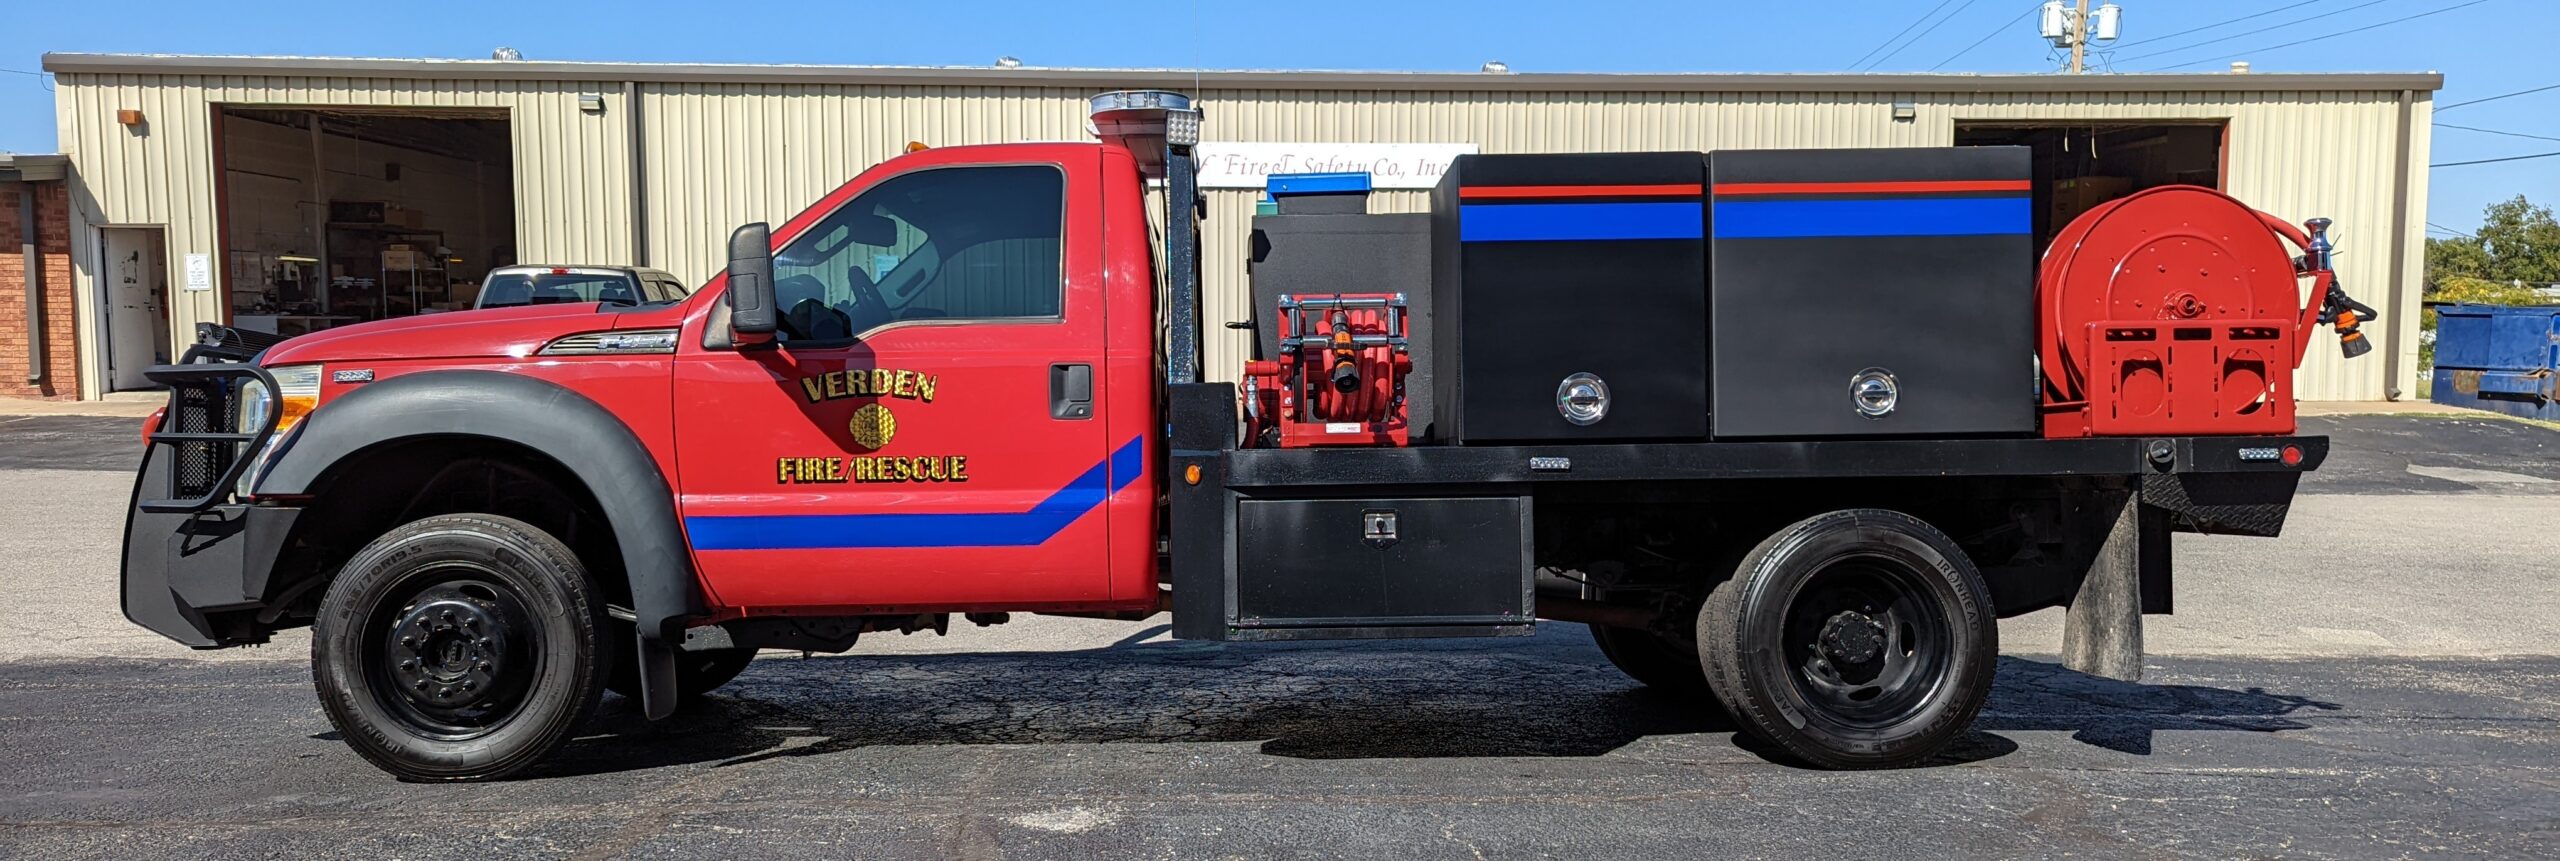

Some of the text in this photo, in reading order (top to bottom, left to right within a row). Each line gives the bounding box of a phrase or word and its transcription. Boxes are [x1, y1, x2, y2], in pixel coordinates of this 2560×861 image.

[1224, 154, 1268, 176] Fire
[801, 368, 938, 403] VERDEN
[777, 456, 969, 484] FIRE/RESCUE
[1936, 559, 1979, 631] IRONHEAD
